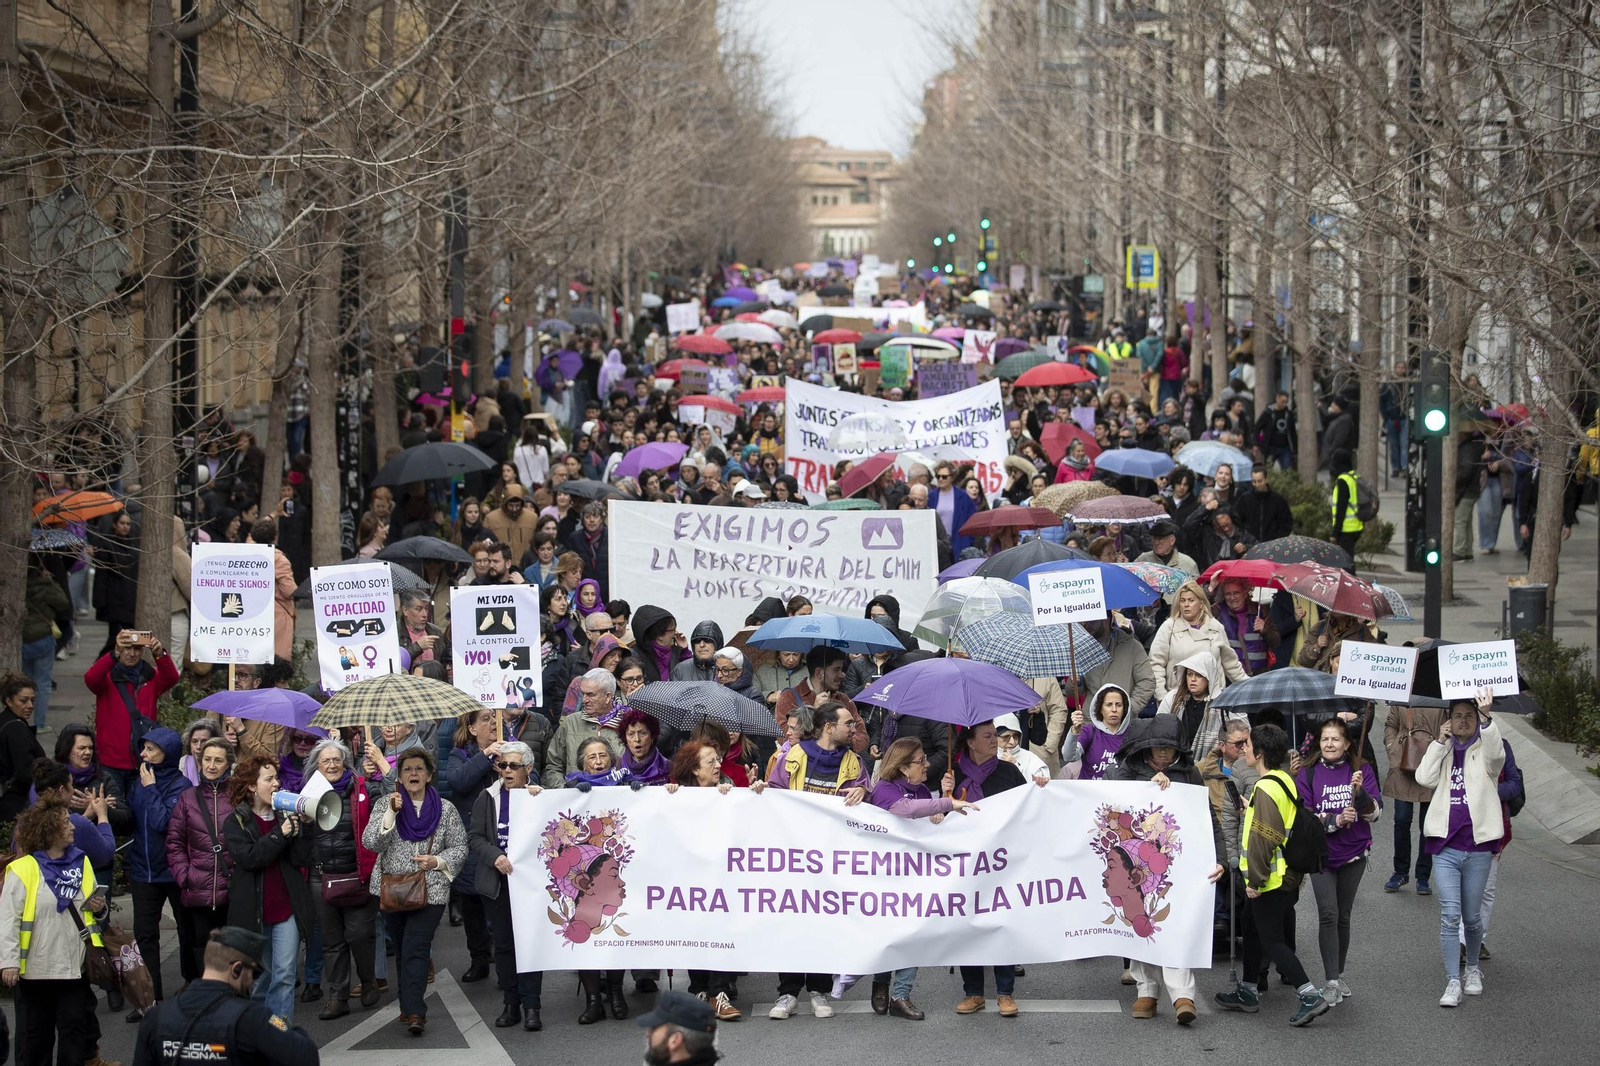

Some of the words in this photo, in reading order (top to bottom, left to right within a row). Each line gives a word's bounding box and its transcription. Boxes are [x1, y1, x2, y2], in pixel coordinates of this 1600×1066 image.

[795, 403, 838, 427] JUNTAS
[907, 420, 916, 434] Y
[923, 402, 1002, 431] ORGANIZADAS
[673, 512, 838, 548] EXIGIMOS
[228, 560, 268, 569] DERECHO
[650, 547, 681, 571] LA
[693, 548, 827, 580] REAPERTURA
[839, 556, 876, 581] DEL
[196, 579, 225, 588] LENGUA
[227, 580, 236, 588] DE
[239, 580, 270, 589] SIGNOS!
[314, 582, 335, 594] ¡SOY
[337, 580, 366, 591] COMO
[368, 578, 390, 588] SOY!
[683, 576, 763, 602] MONTES
[1052, 578, 1095, 589] aspaym
[1062, 587, 1096, 597] granada
[477, 596, 489, 605] MI
[491, 595, 514, 604] VIDA
[324, 600, 386, 617] CAPACIDAD
[1037, 607, 1051, 615] Por
[1064, 601, 1101, 613] Igualdad
[193, 626, 216, 637] ¿ME
[221, 627, 271, 637] APOYAS?
[480, 637, 525, 645] CONTROLO
[217, 648, 231, 656] 8M
[464, 650, 491, 666] ¡YO!
[1363, 652, 1407, 665] aspaym
[1462, 649, 1508, 662] aspaym
[1370, 663, 1406, 674] granada
[1472, 659, 1508, 671] granada
[345, 674, 359, 682] 8M
[1340, 675, 1356, 685] Por
[1358, 677, 1367, 686] la
[1369, 678, 1407, 691] Igualdad
[1445, 679, 1461, 688] Por
[1463, 678, 1471, 687] la
[1473, 675, 1514, 687] Igualdad
[480, 693, 495, 701] 8M
[846, 819, 889, 834] 8M-2025
[727, 847, 823, 874] REDES
[832, 847, 1008, 877] FEMINISTAS
[646, 885, 730, 913] PARA
[737, 887, 967, 917] TRANSFORMAR
[974, 887, 1012, 914] LA
[1016, 876, 1087, 907] VIDA
[1065, 928, 1113, 938] PLATAFORMA
[1113, 928, 1134, 938] 8M/25N
[665, 940, 699, 948] UNITARIO
